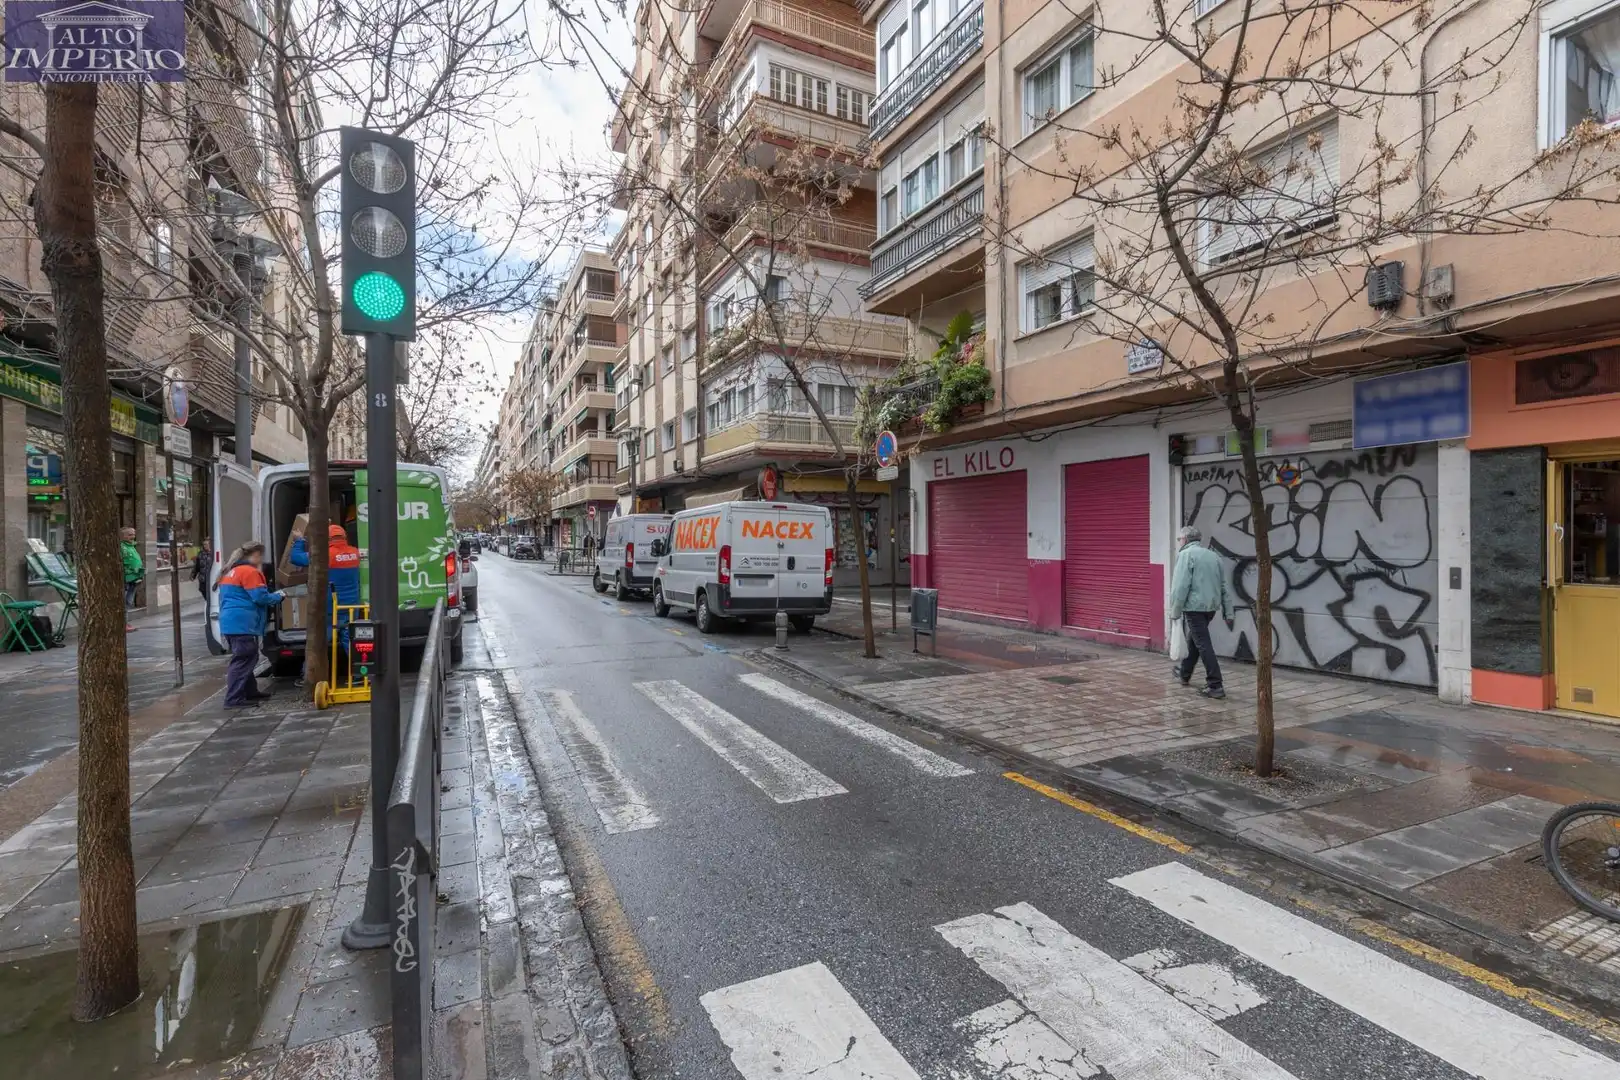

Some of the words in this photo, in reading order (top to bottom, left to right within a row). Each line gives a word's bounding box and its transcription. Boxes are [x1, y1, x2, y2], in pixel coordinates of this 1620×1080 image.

[933, 456, 955, 478] EL
[964, 446, 1015, 474] KILO
[357, 501, 430, 522] SUR
[675, 516, 721, 552] NACEX
[742, 520, 815, 540] NACEX
